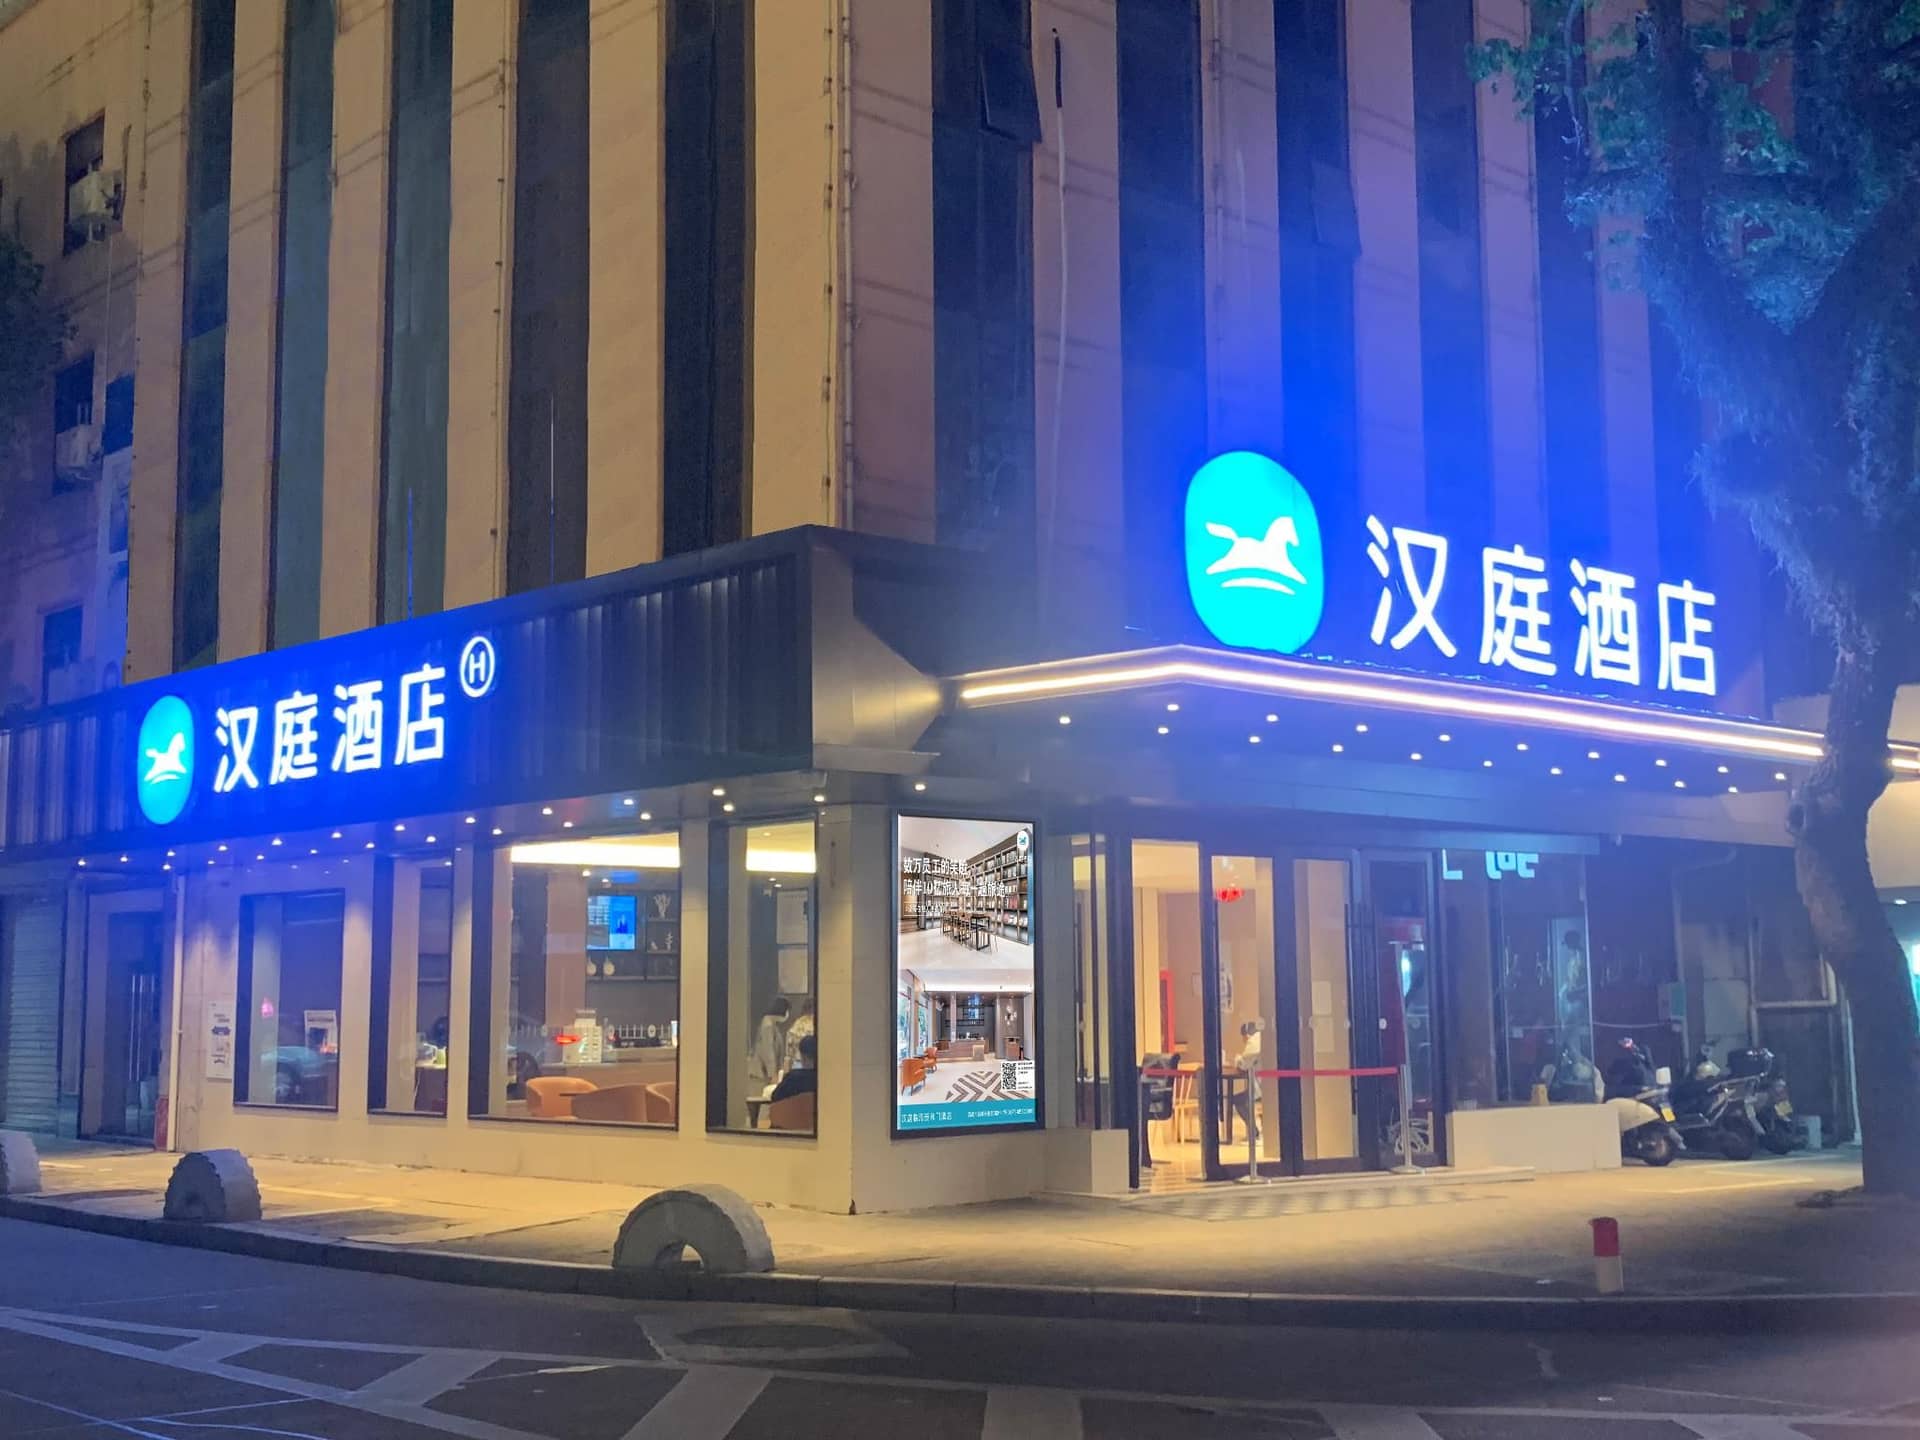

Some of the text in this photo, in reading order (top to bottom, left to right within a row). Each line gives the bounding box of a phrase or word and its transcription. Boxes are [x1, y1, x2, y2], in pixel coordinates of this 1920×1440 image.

[1366, 514, 1717, 696] 汉庭酒店
[213, 663, 446, 793] 汉庭酒店
